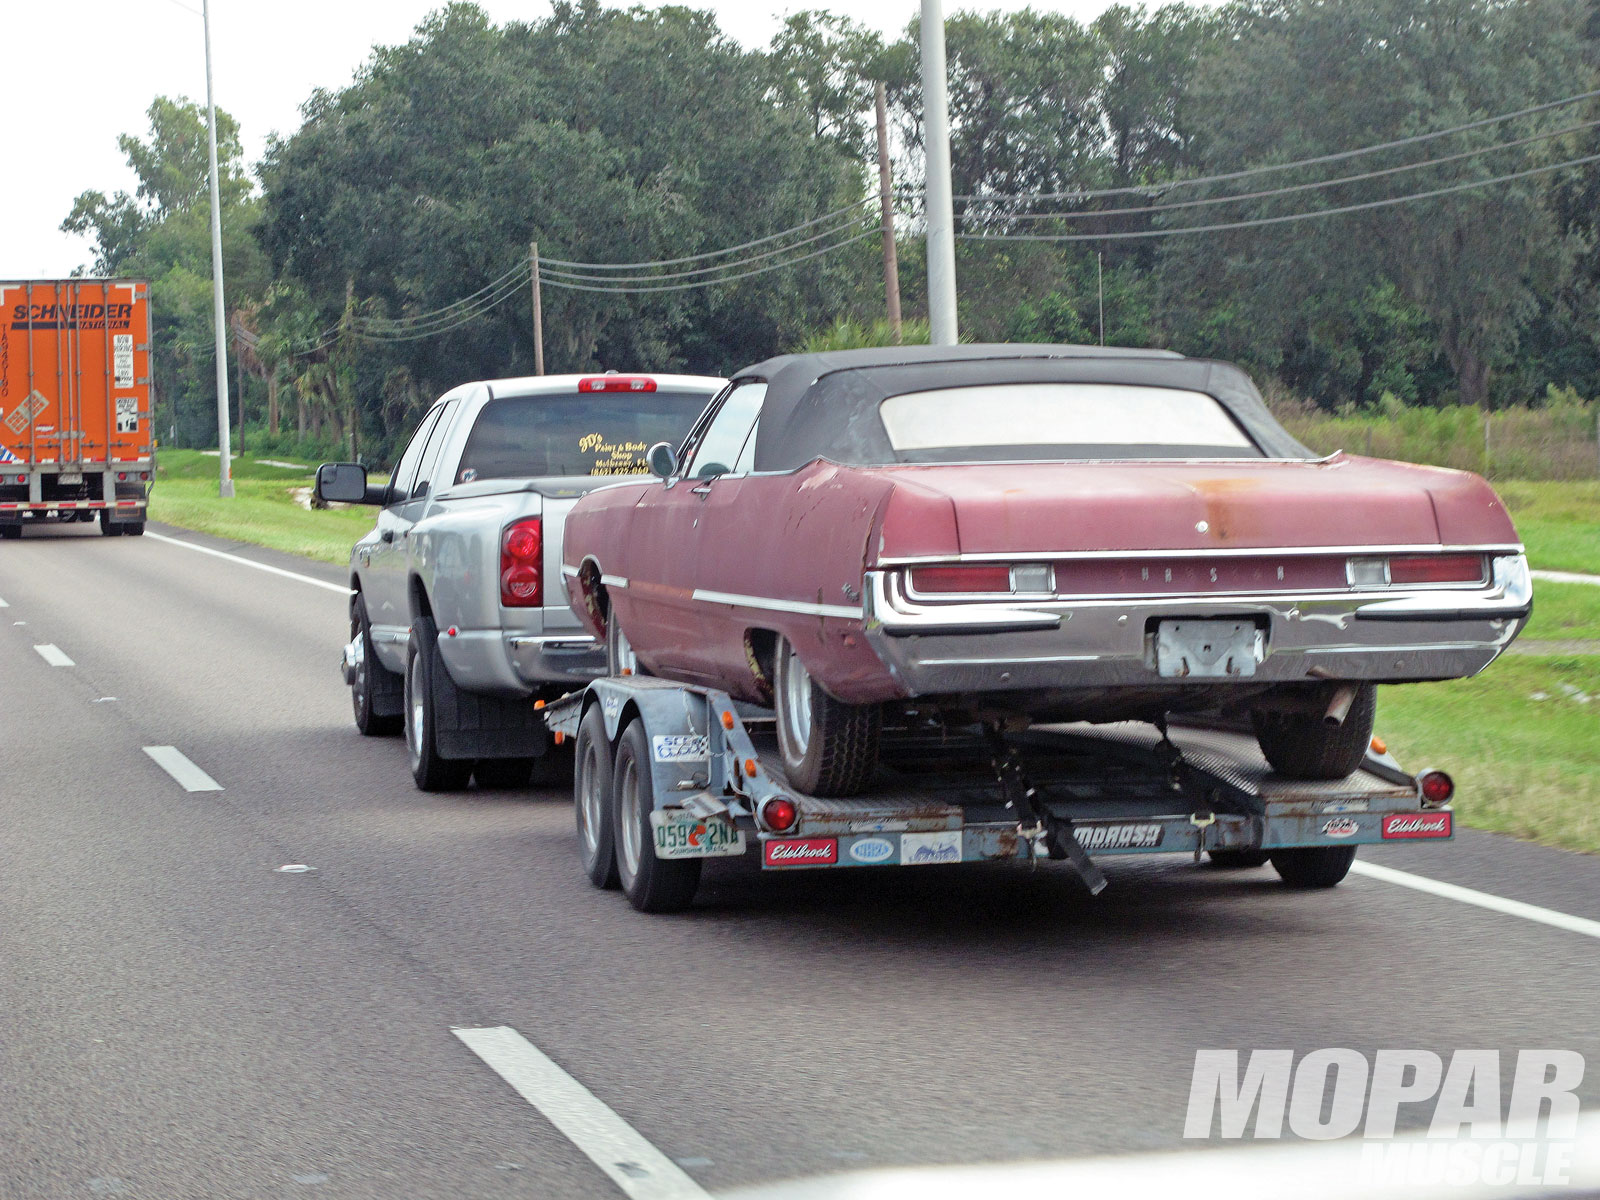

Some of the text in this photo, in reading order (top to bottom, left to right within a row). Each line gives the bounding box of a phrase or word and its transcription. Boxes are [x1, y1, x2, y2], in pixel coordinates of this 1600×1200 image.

[14, 304, 132, 319] SCHNEIDER
[595, 443, 616, 453] Paint
[625, 441, 647, 453] Body
[611, 451, 633, 461] Shop
[1387, 817, 1445, 833] Edelbrock
[1073, 824, 1161, 849] MOROSO
[770, 843, 831, 860] Edelbrock
